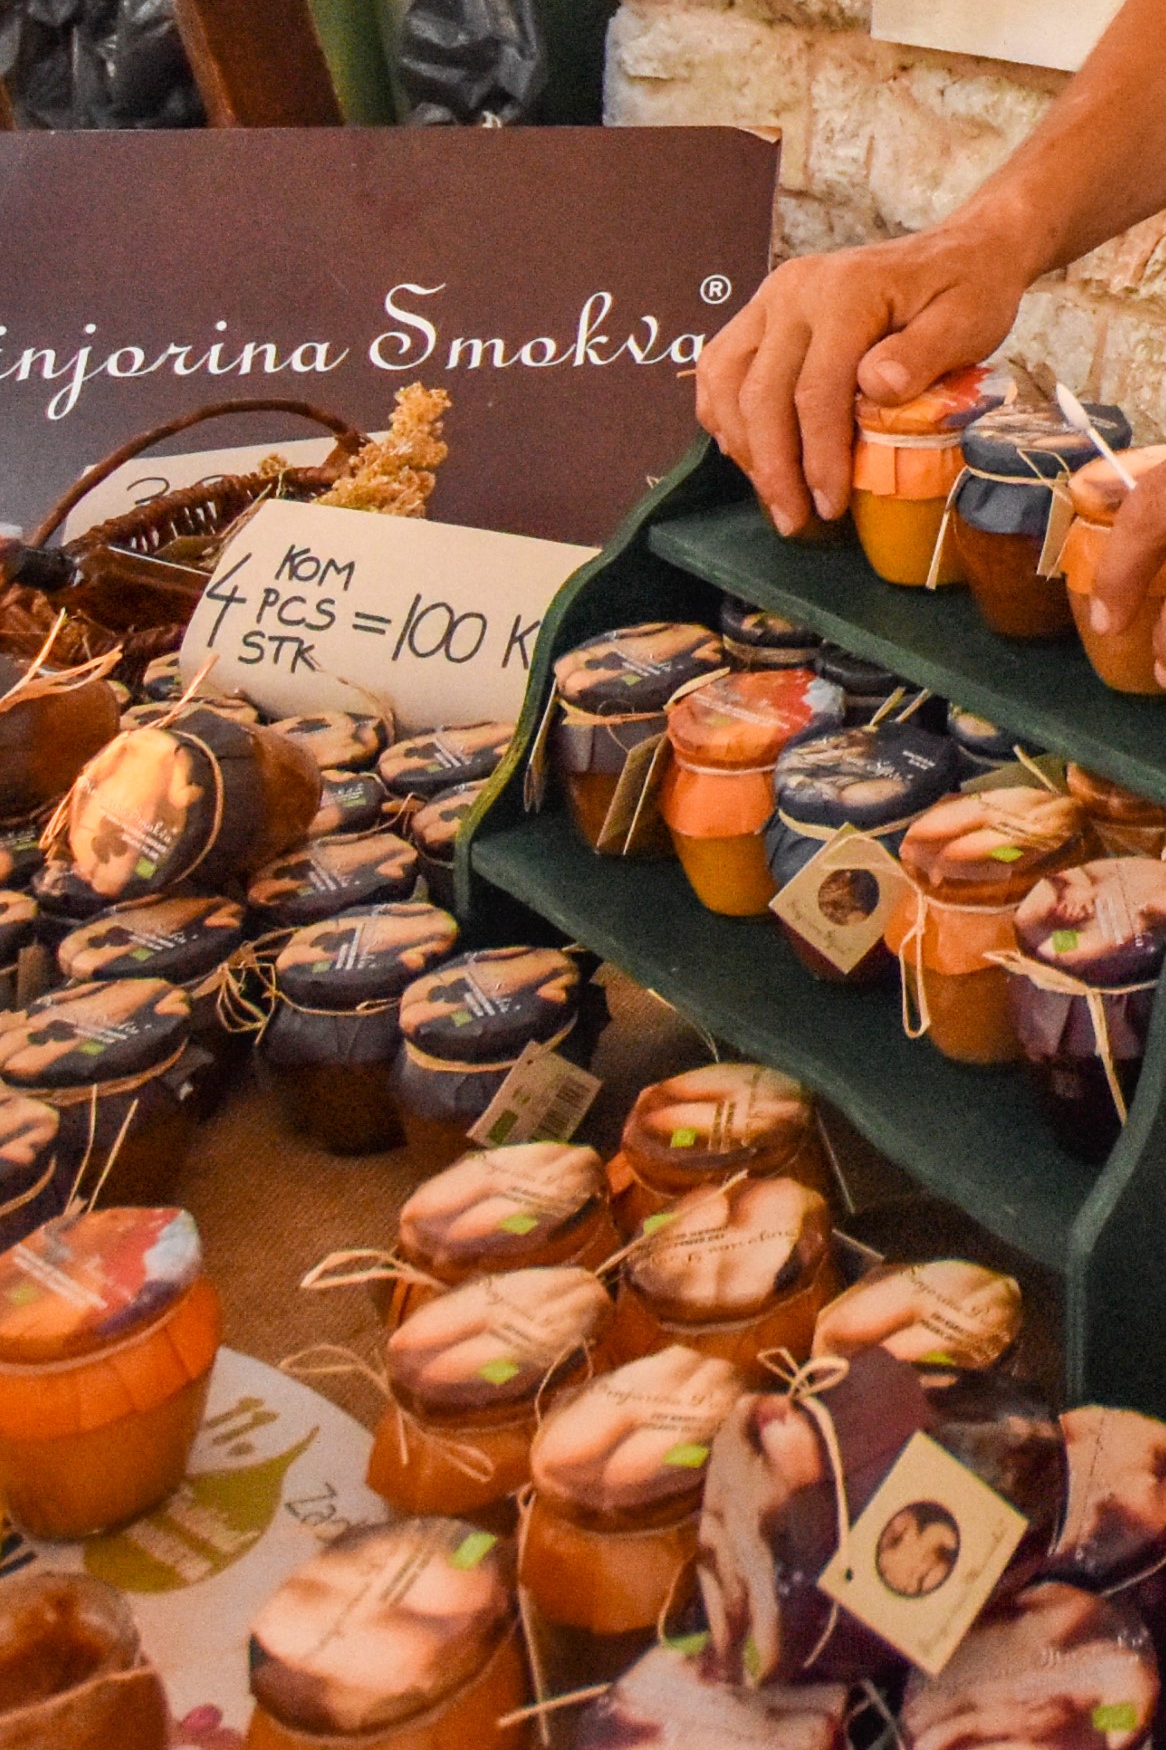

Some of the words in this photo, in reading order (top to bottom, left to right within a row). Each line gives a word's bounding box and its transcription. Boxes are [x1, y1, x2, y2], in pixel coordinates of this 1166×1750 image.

[369, 282, 706, 370] Smokva
[206, 552, 253, 649] 4
[256, 587, 336, 631] PCS
[275, 543, 356, 591] KOM
[238, 630, 321, 674] STK
